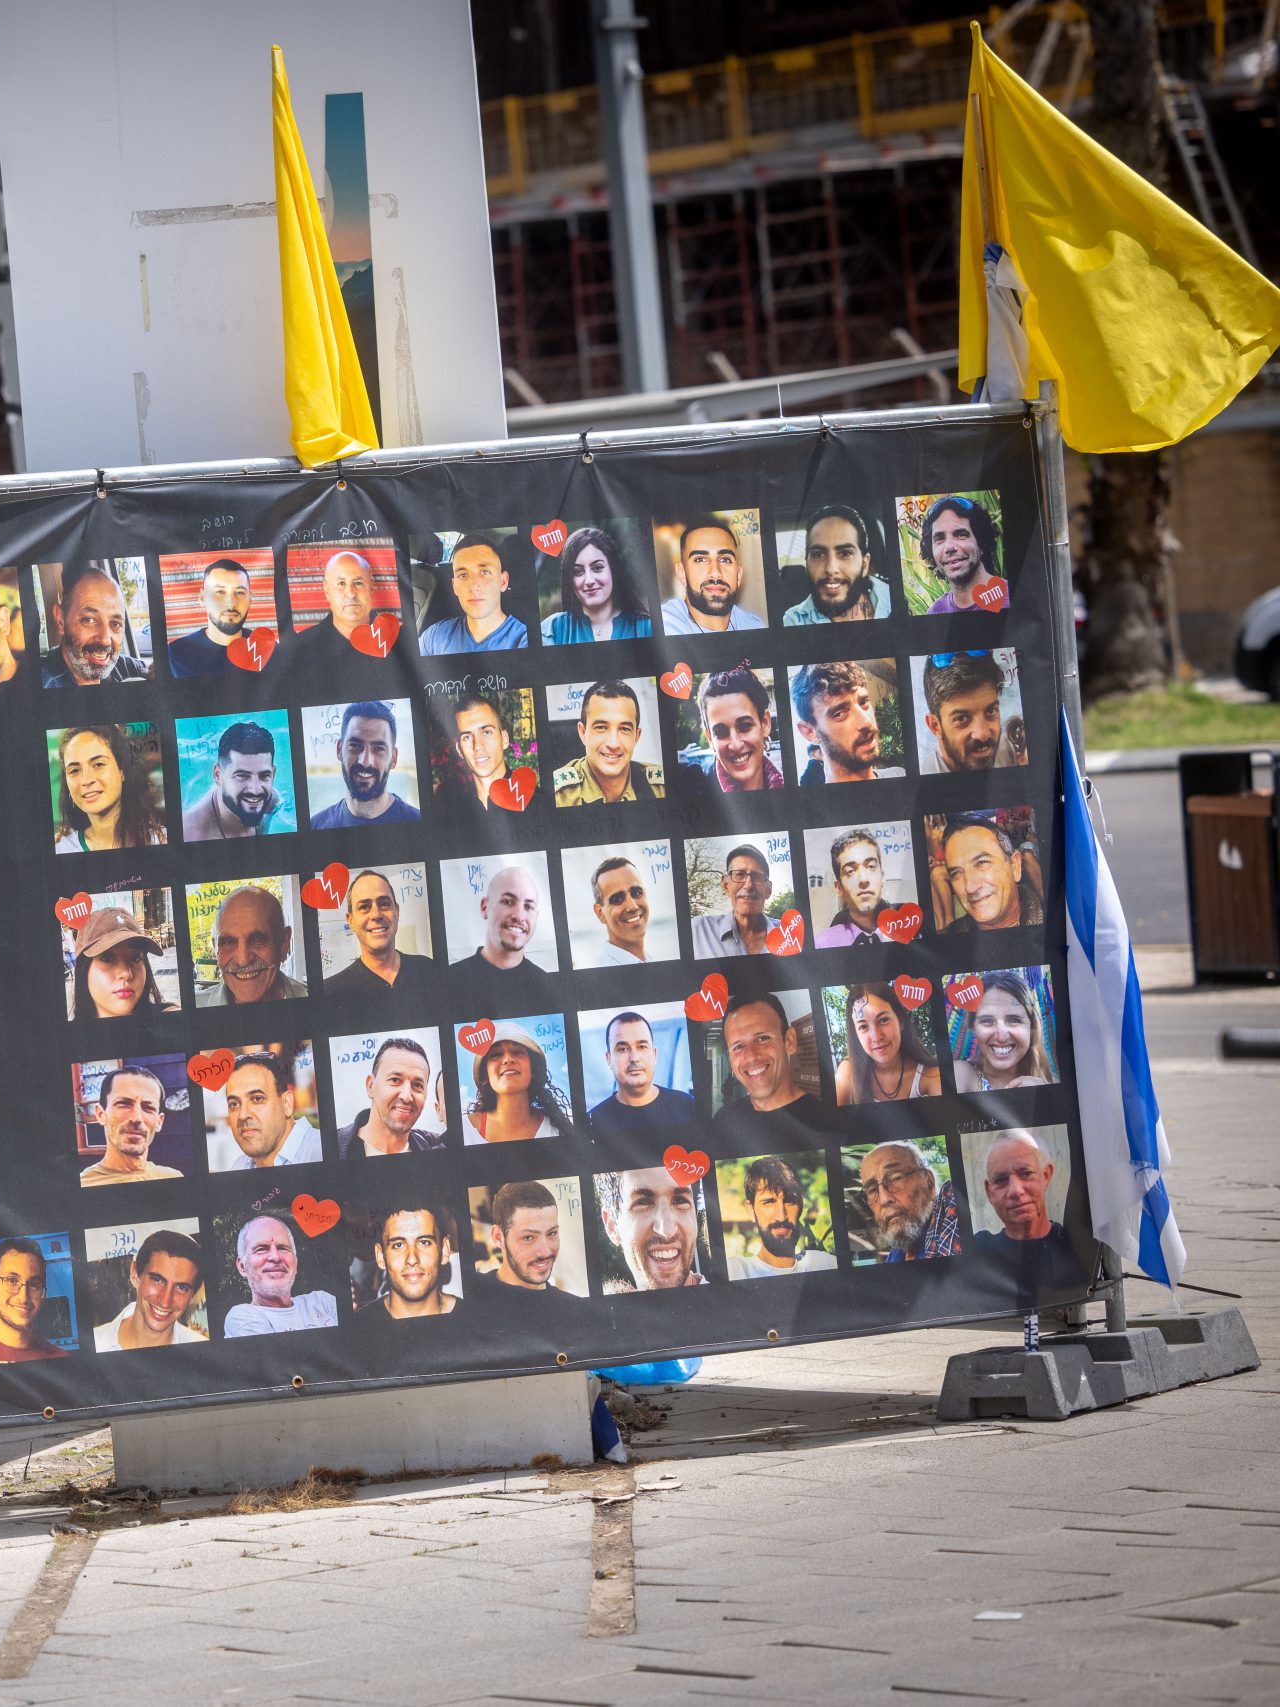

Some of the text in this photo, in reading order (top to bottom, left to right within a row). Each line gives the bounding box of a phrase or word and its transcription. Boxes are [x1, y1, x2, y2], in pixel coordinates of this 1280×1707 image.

[338, 519, 379, 538] הושב
[537, 528, 563, 548] חזרתי
[978, 586, 1004, 606] חזרתי
[423, 674, 508, 697] הושב לקבורה
[667, 672, 690, 693] חזרתי
[399, 867, 423, 882] צחי
[62, 902, 88, 921] חזרתי
[886, 914, 920, 934] חזרתי
[901, 984, 925, 1001] חזרתי
[955, 984, 981, 1004] חזרתי
[466, 1029, 492, 1048] חזרתי
[669, 1159, 705, 1175] חזרתי
